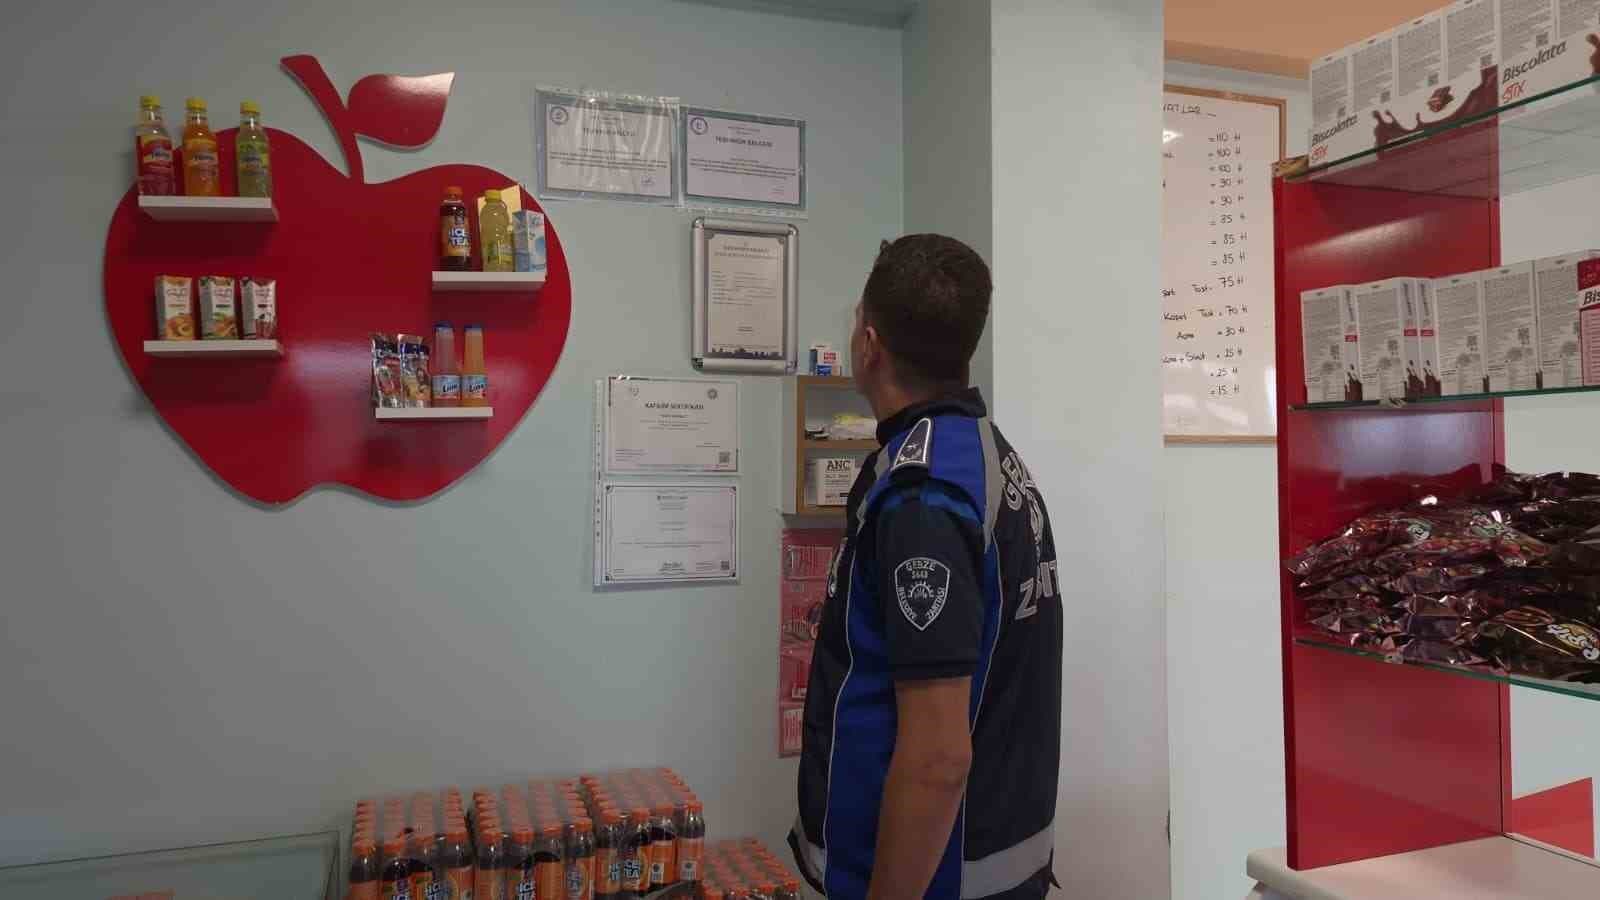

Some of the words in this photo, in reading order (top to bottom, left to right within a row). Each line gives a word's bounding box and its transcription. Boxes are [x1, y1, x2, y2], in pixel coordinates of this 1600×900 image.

[1502, 40, 1568, 82] Biscolata
[1312, 113, 1359, 145] Biscolata
[827, 459, 849, 472] ANC
[905, 560, 937, 572] GEBZE
